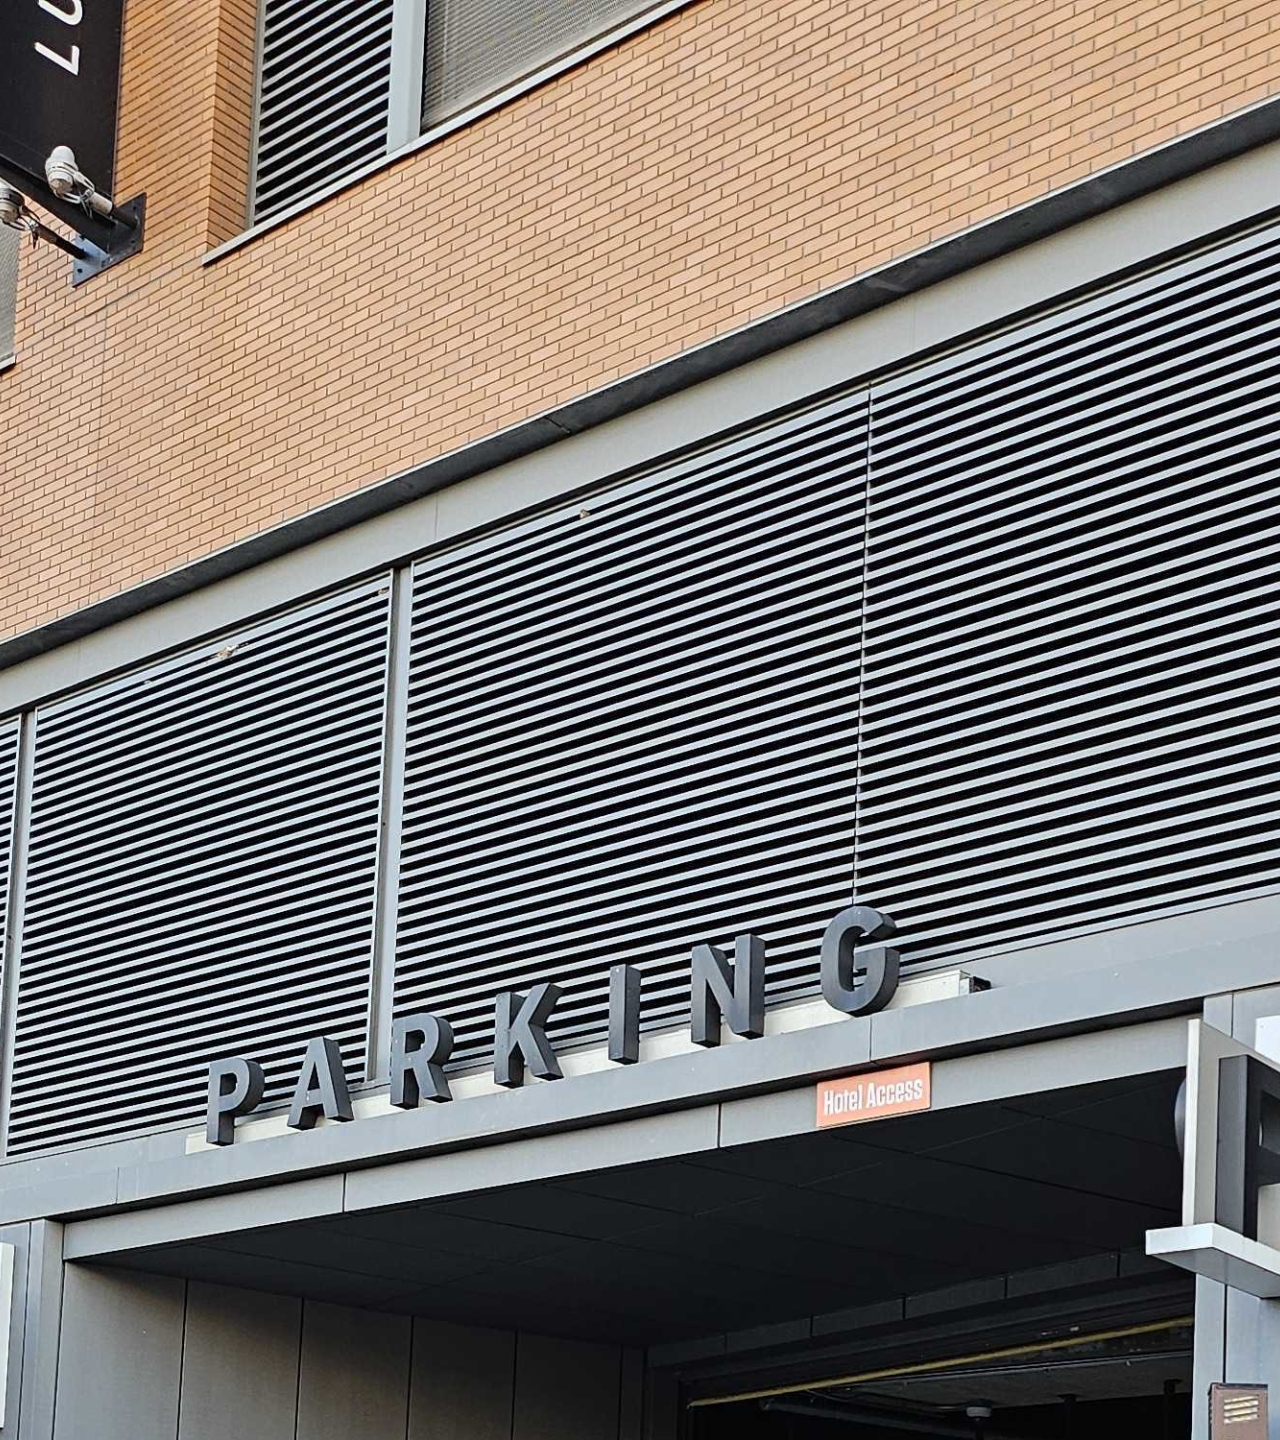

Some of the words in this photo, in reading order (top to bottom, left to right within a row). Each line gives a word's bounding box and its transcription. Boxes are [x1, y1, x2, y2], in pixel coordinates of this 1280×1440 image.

[205, 905, 901, 1146] PARKING
[823, 1083, 863, 1115] Hotel
[866, 1078, 923, 1109] Access
